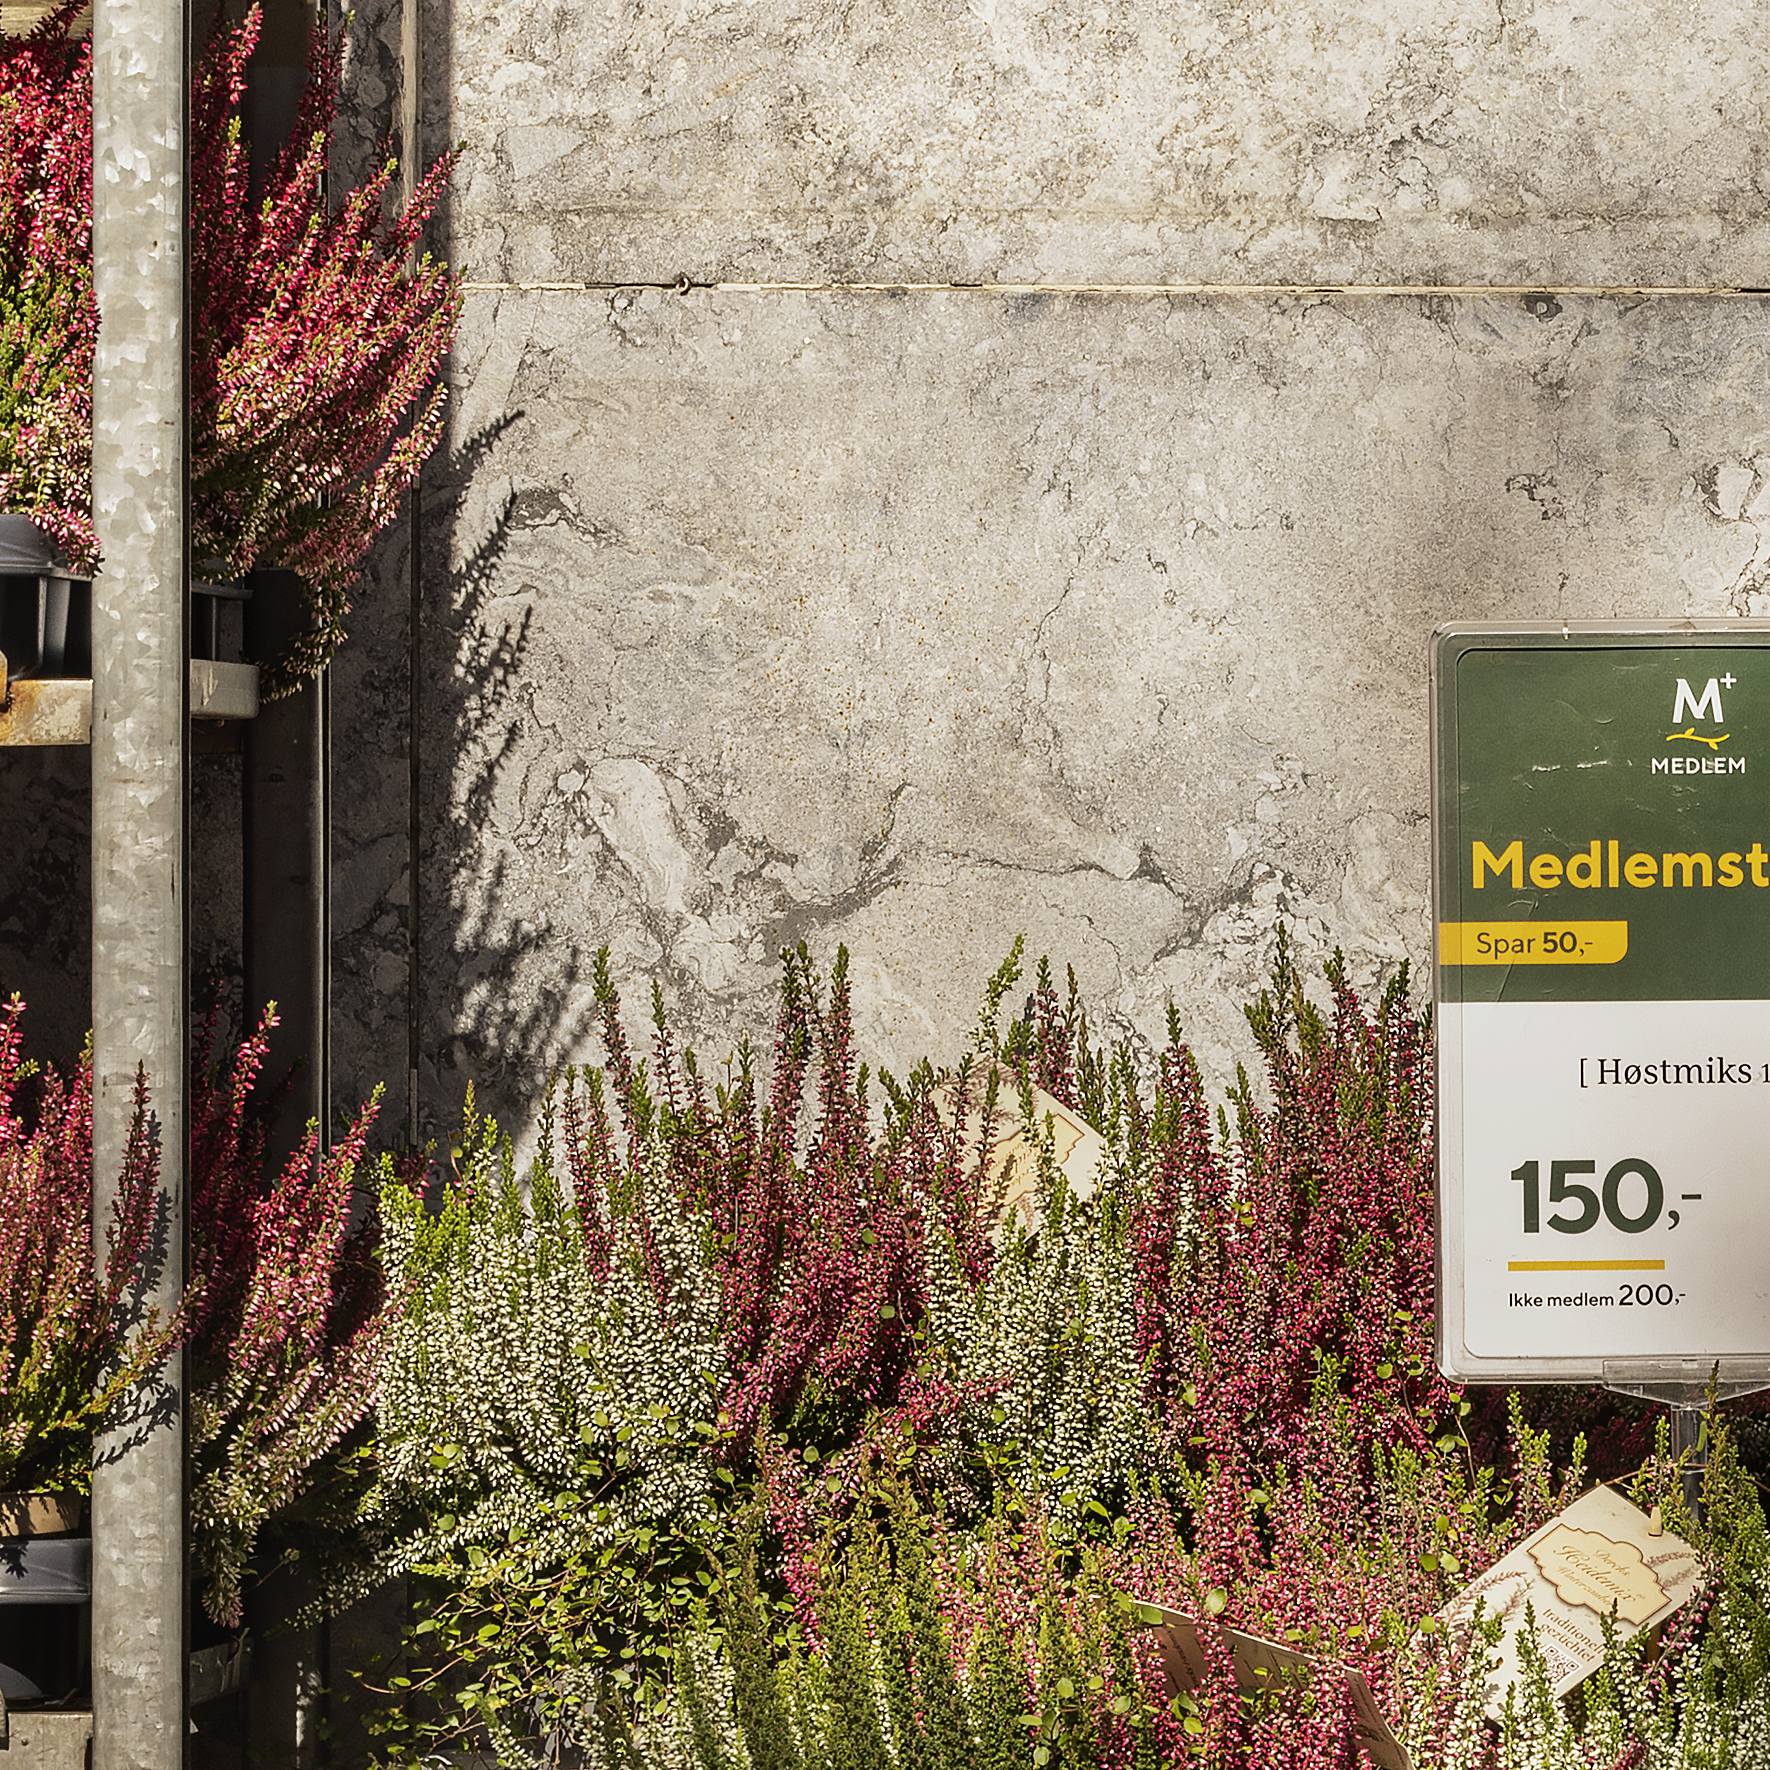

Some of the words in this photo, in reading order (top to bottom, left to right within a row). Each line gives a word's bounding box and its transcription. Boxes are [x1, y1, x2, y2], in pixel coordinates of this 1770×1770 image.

[1651, 757, 1746, 774] MEDLEM
[1476, 932, 1536, 959] Spar
[1543, 932, 1593, 956] 50,-
[1598, 1056, 1752, 1085] Høstmiks
[1510, 1158, 1702, 1234] 150,-
[1509, 1292, 1543, 1307] Ikke
[1547, 1292, 1614, 1307] medlem
[1618, 1284, 1686, 1307] 200,-
[1553, 1545, 1637, 1602] Heidemix
